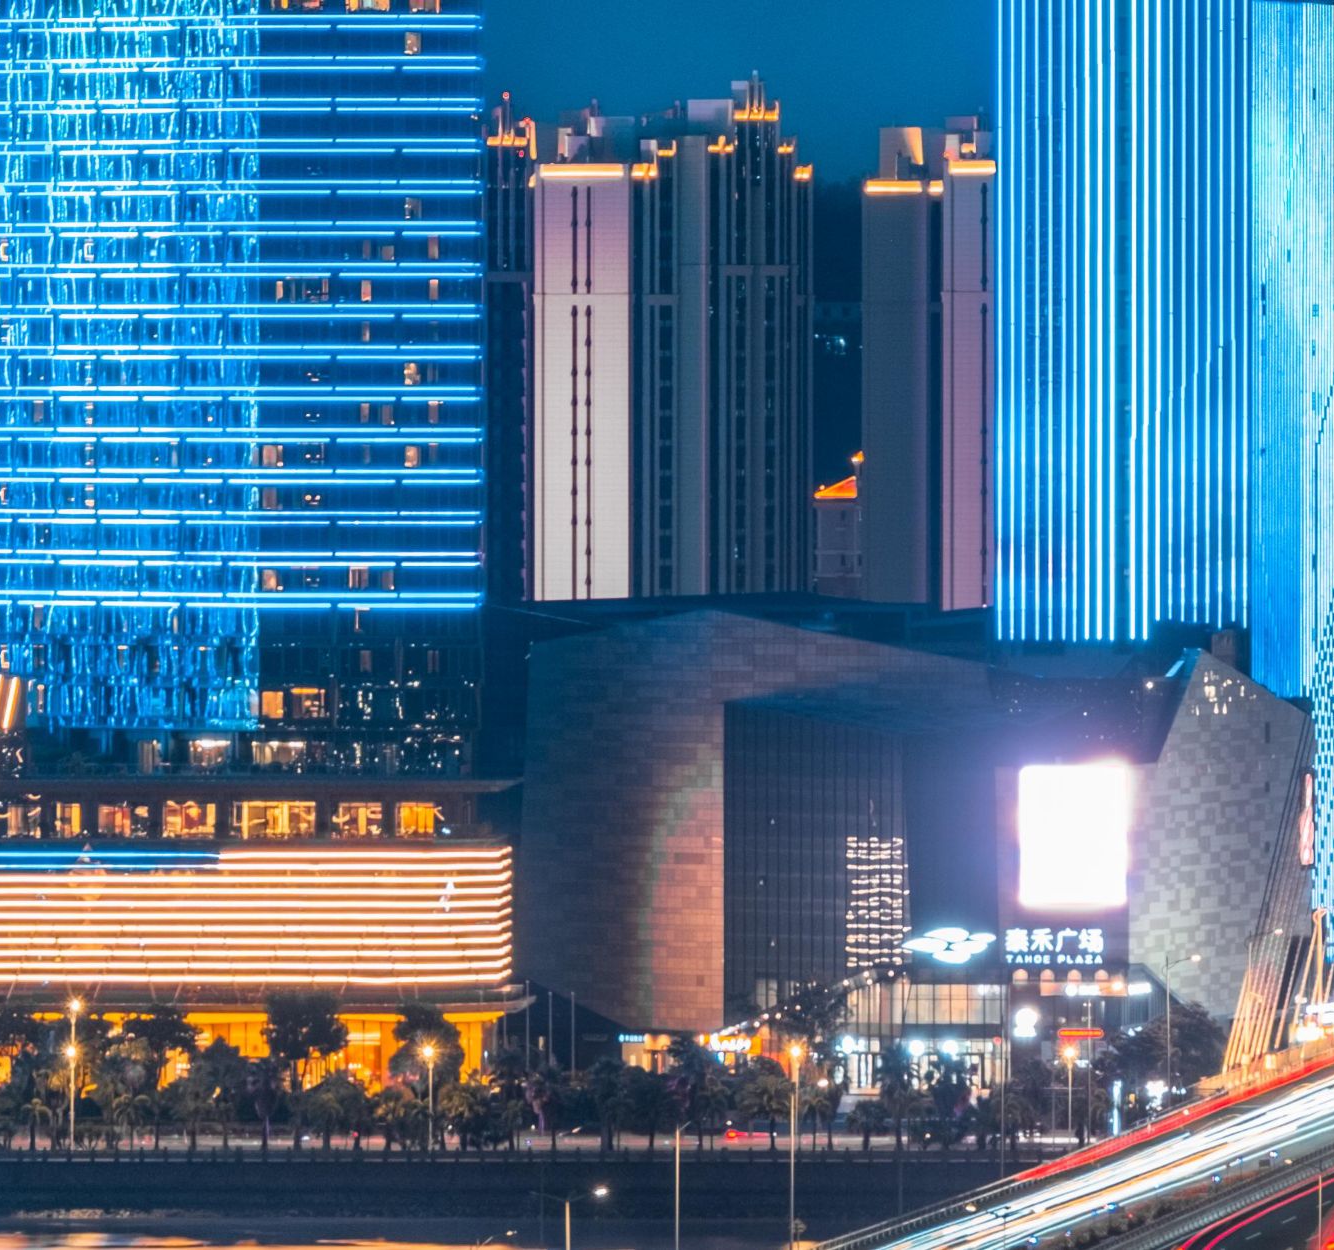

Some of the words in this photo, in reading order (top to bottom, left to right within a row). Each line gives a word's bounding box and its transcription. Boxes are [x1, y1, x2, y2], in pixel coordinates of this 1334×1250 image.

[1005, 928, 1104, 953] 泰禾广场
[1005, 954, 1051, 965] TAHOE
[1057, 954, 1104, 965] PLAZA
